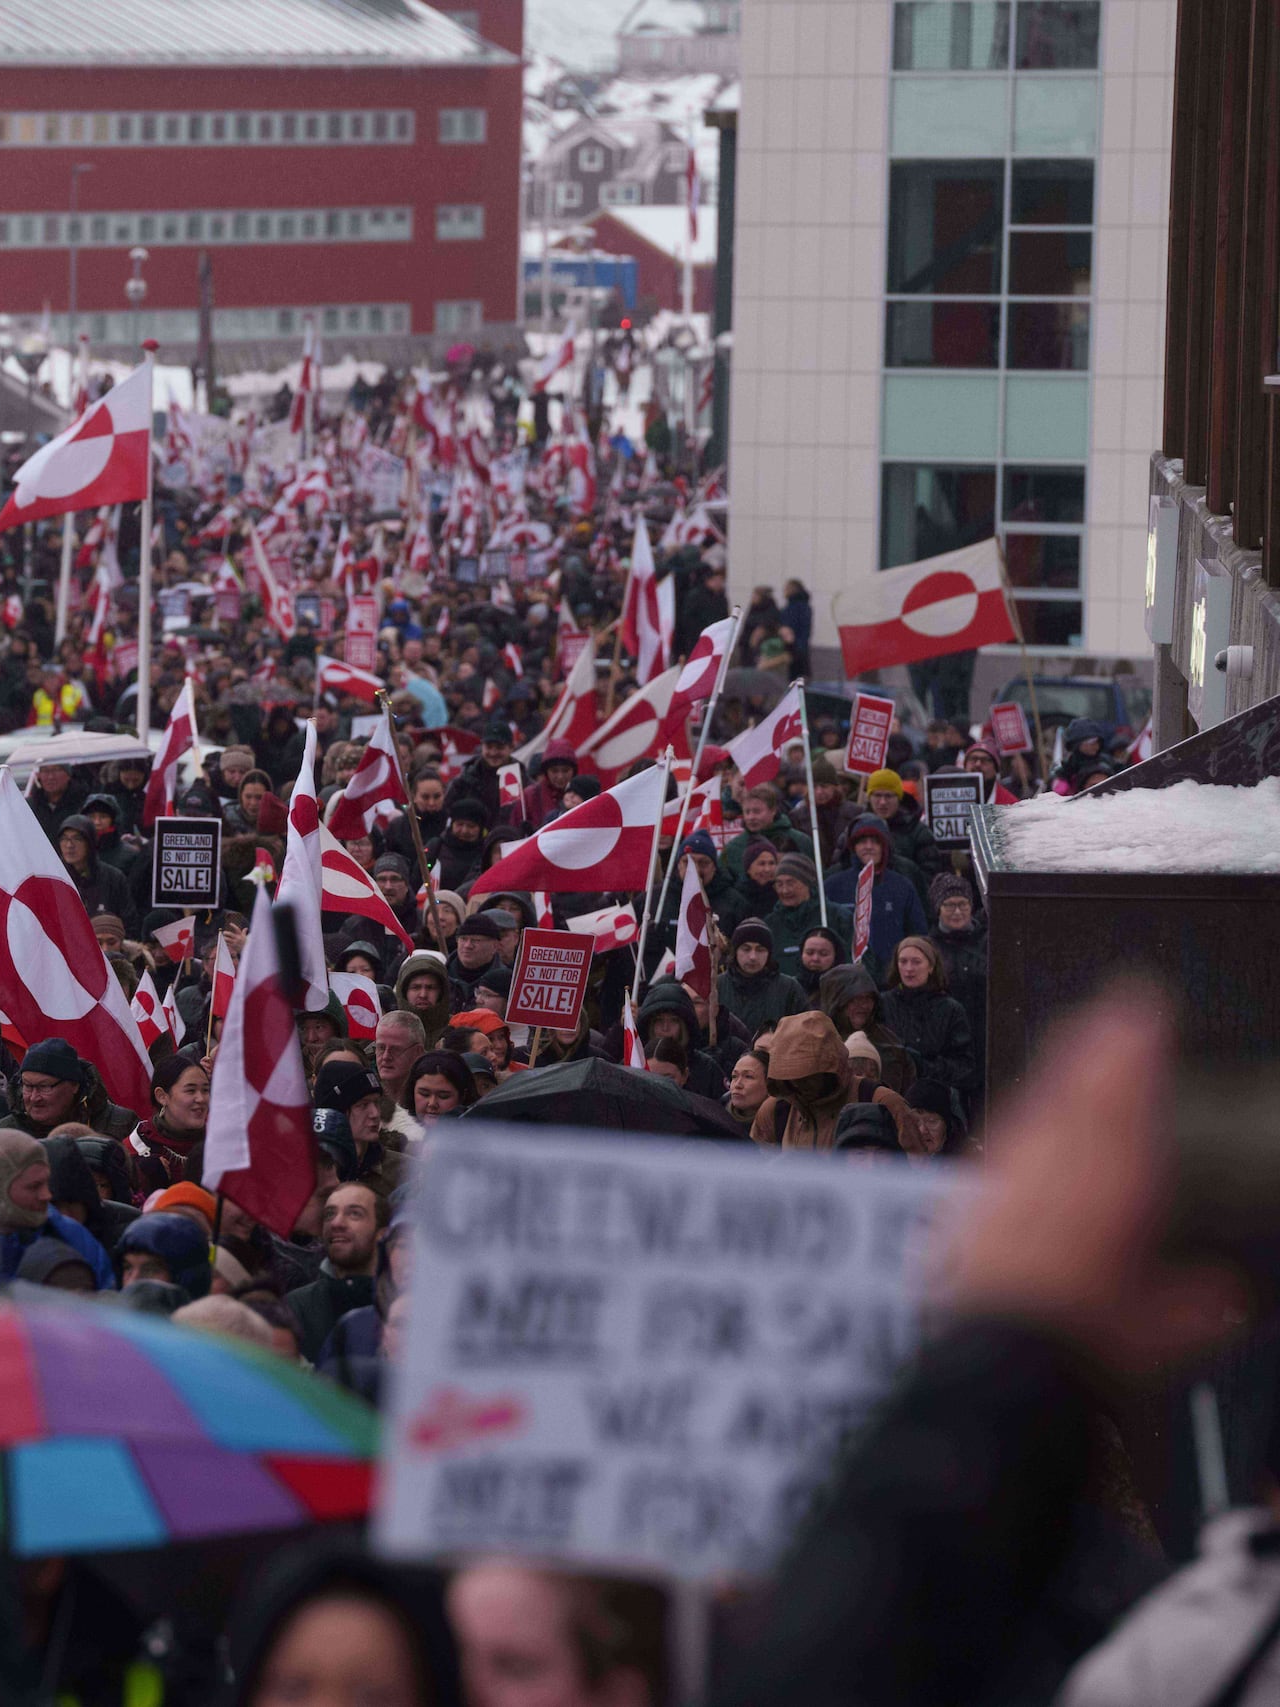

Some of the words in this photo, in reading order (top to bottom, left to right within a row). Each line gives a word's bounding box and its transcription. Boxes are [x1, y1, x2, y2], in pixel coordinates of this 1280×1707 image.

[933, 788, 974, 799] GREENLAND
[164, 834, 211, 847] GREENLAND
[164, 851, 172, 862] IS
[175, 851, 191, 863] NOT
[195, 852, 210, 863] FOR
[163, 868, 209, 891] SALE!
[531, 948, 583, 963] GREENLAND
[526, 966, 536, 978] IS
[540, 967, 558, 980] NOT
[561, 969, 579, 982] FOR
[520, 985, 576, 1013] SALE!
